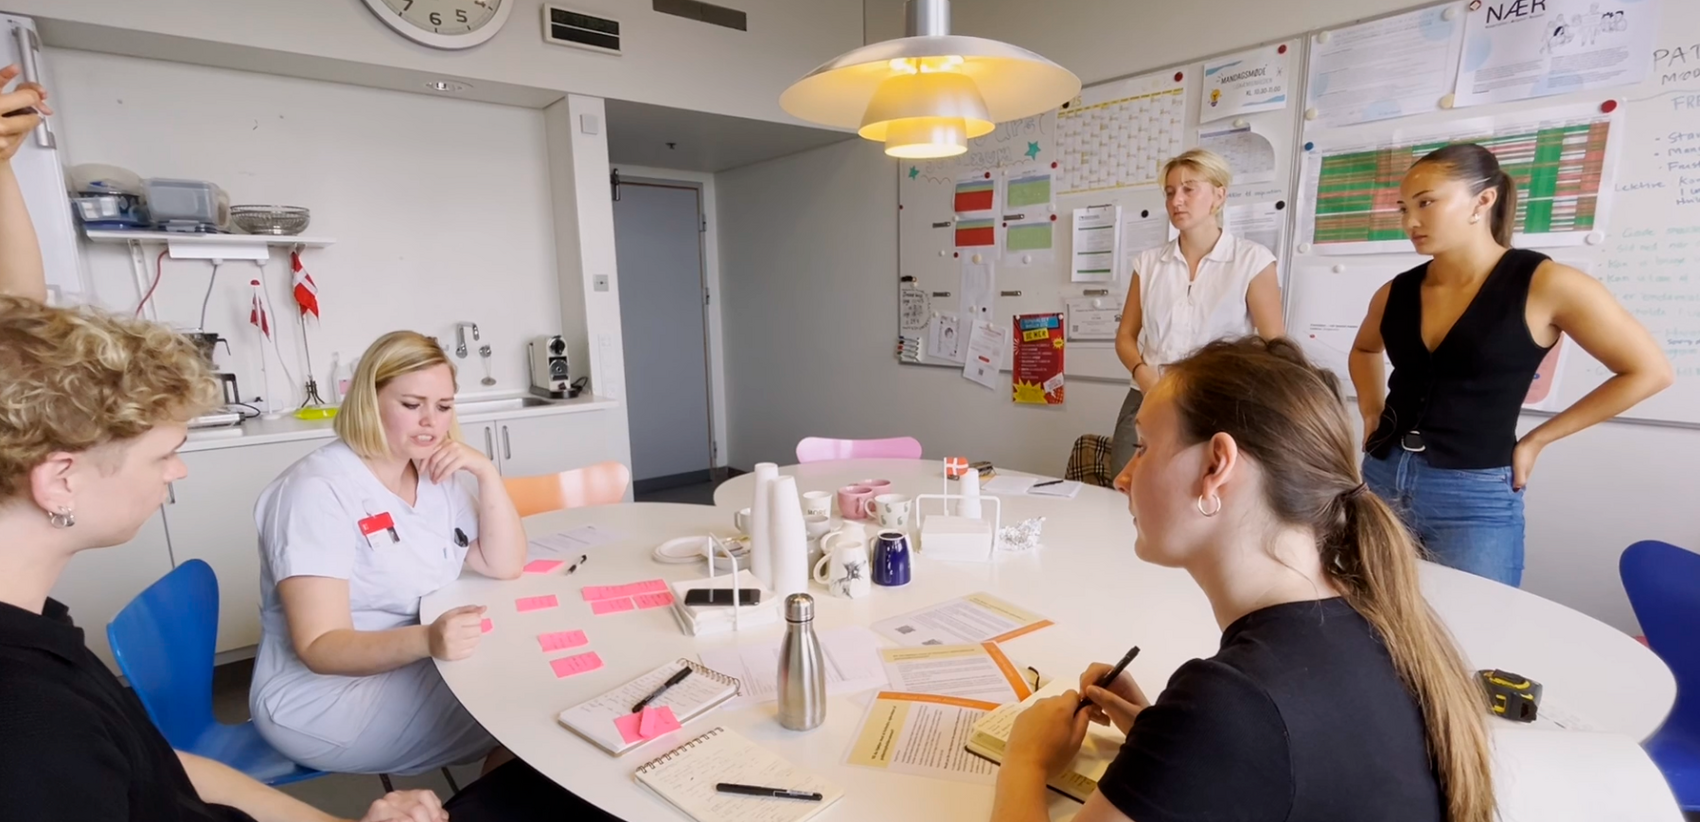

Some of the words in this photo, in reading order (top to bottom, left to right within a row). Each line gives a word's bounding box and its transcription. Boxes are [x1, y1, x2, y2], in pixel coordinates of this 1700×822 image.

[429, 12, 442, 26] 6
[456, 9, 468, 23] 5
[1486, 0, 1546, 24] NÆR
[1221, 67, 1267, 84] MANDAGSMØDE
